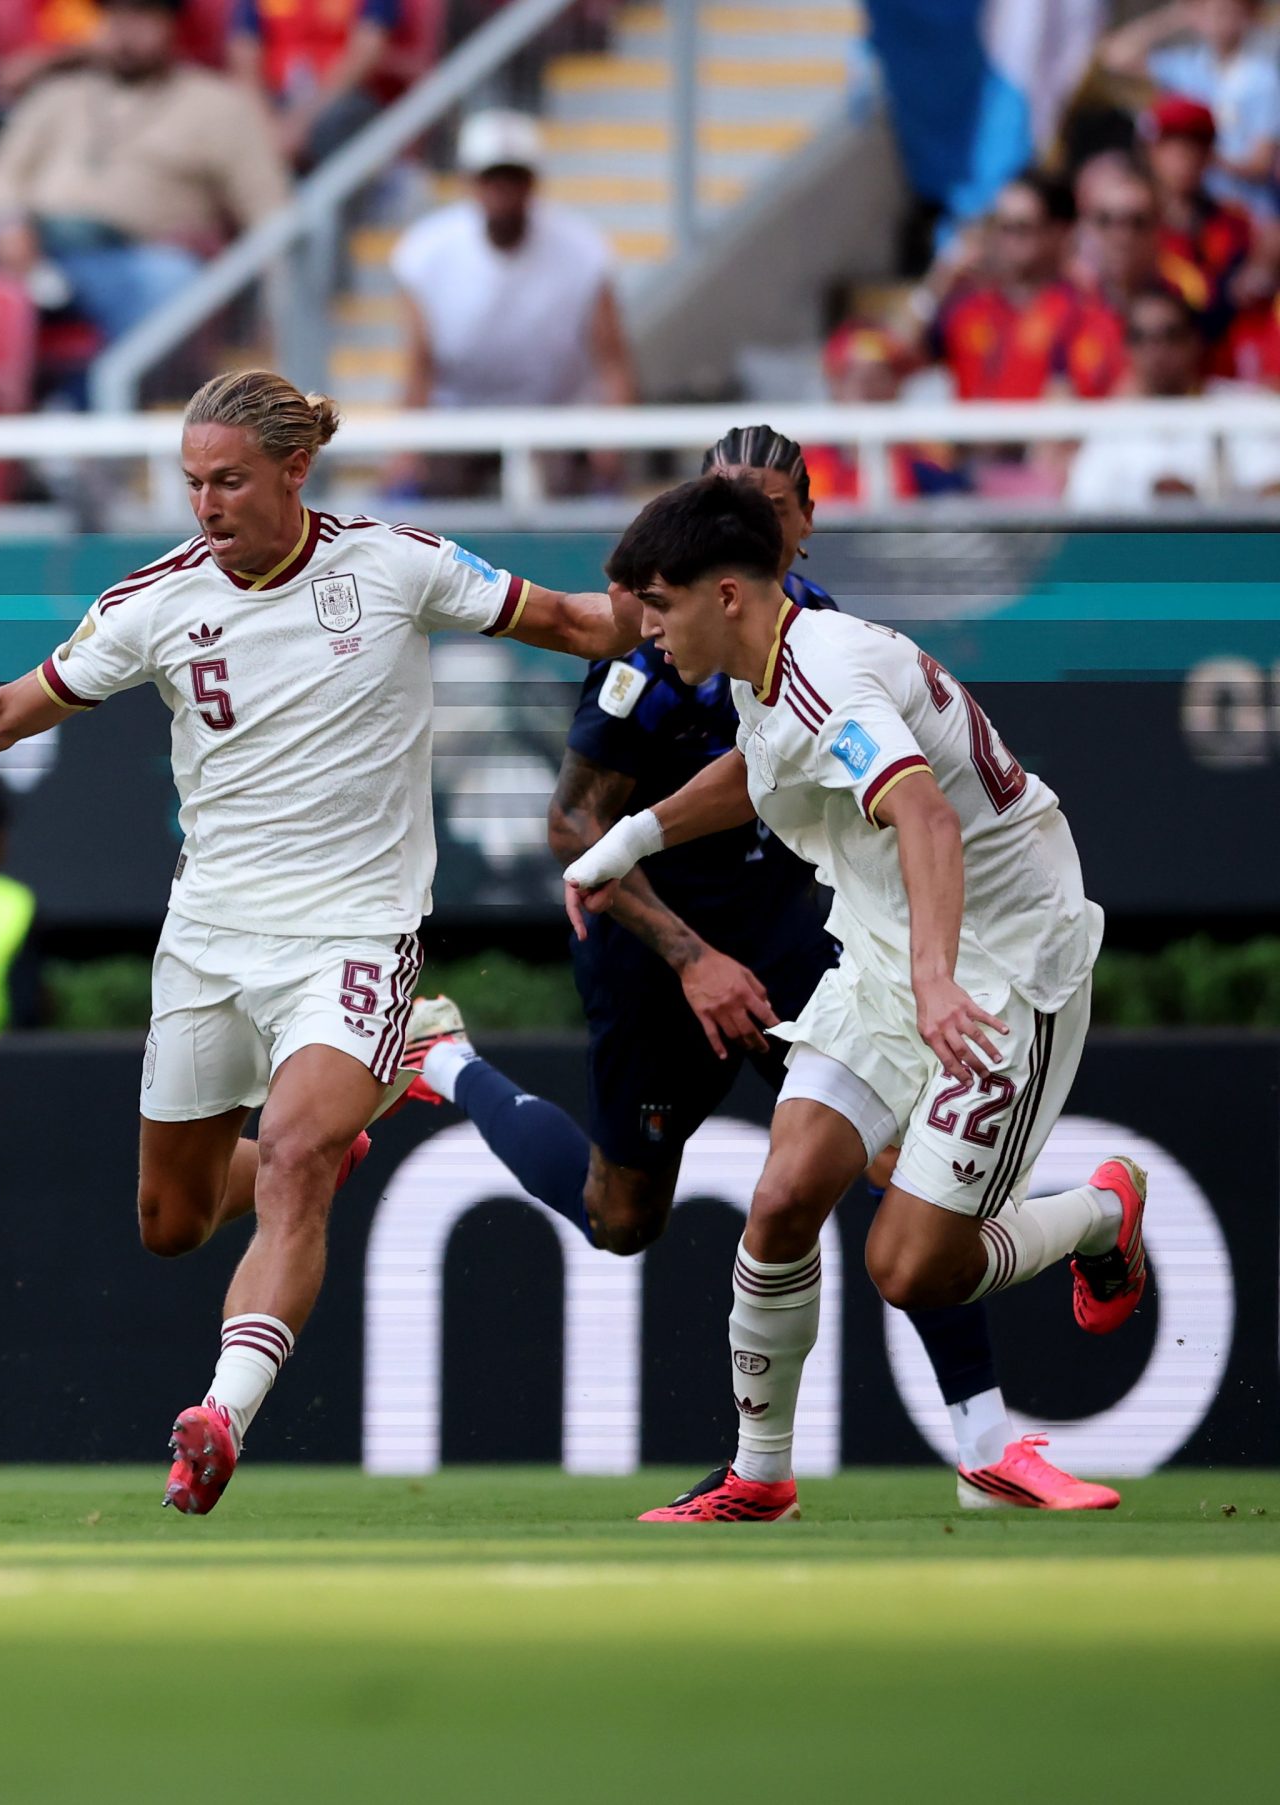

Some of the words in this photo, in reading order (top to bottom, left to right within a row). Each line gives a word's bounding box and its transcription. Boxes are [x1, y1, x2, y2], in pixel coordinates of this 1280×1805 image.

[190, 658, 237, 731] 5
[339, 959, 382, 1015] 5
[927, 1063, 1017, 1149] 22
